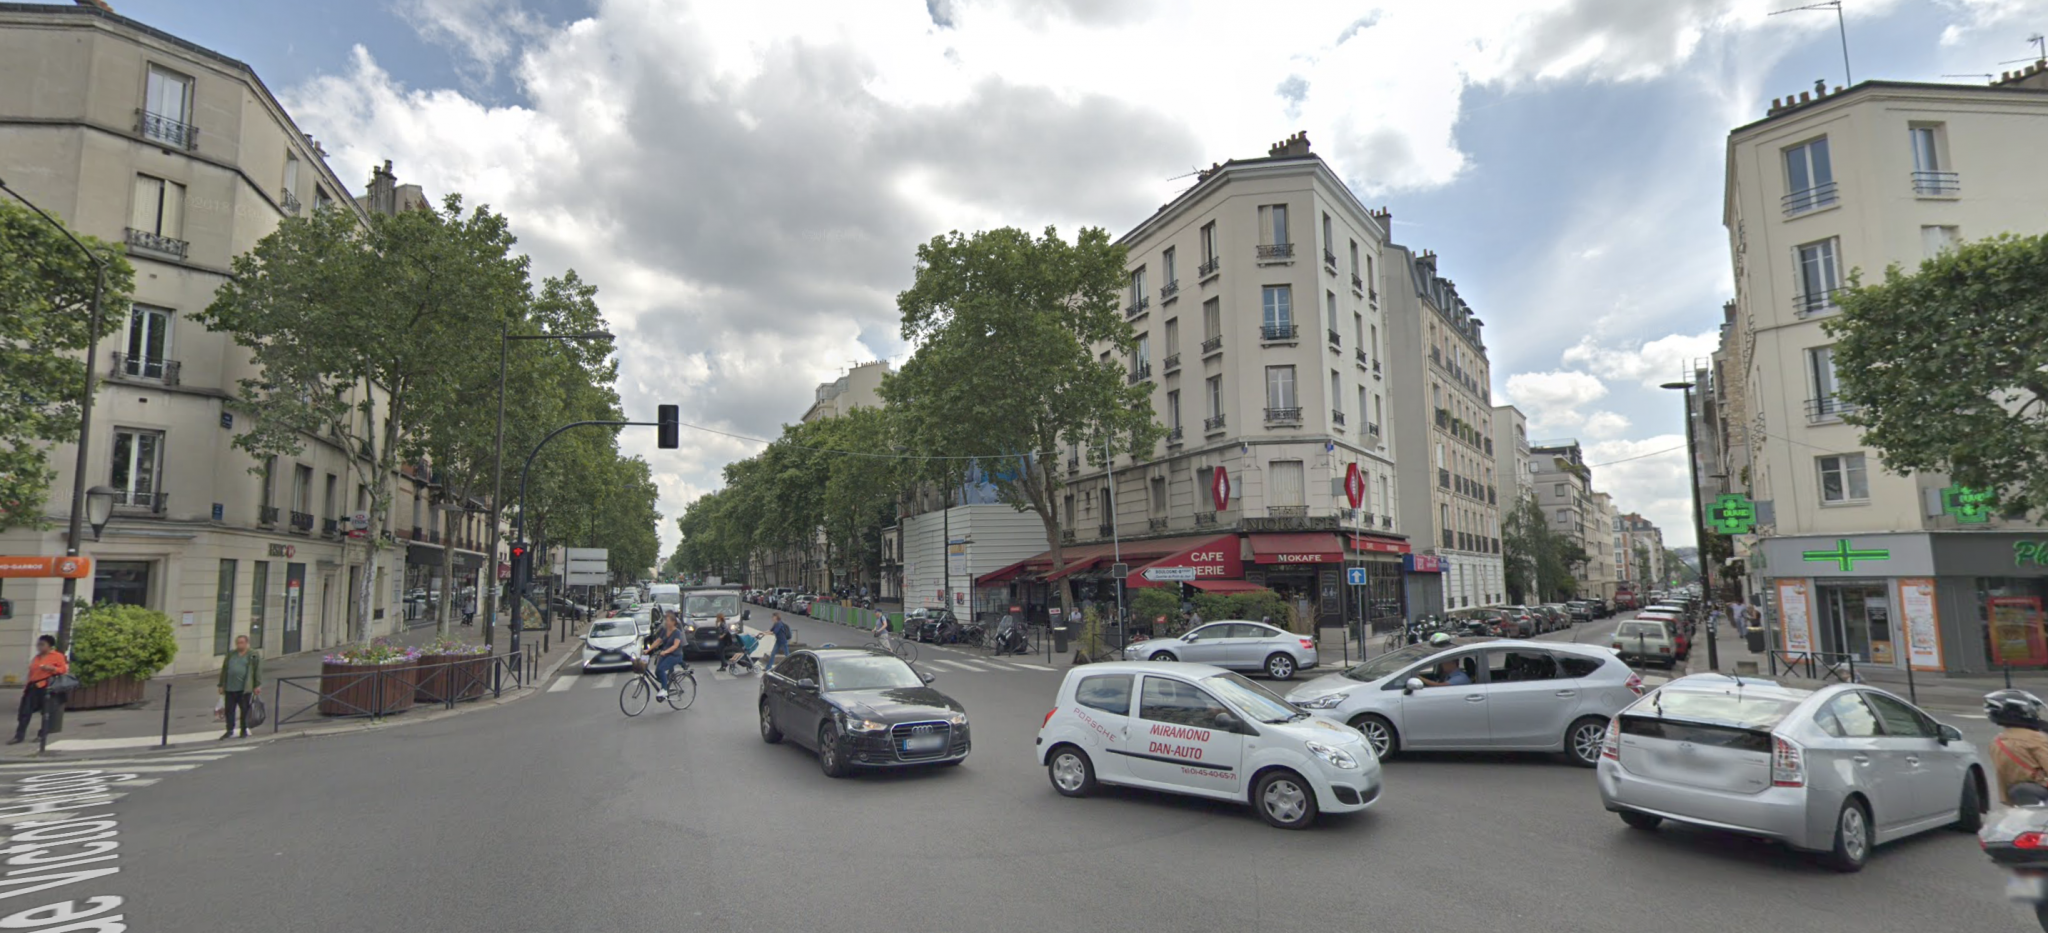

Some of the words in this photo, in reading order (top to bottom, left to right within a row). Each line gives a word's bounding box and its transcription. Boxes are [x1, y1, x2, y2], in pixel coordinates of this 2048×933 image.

[1248, 517, 1337, 529] MOKAFE
[1190, 552, 1224, 562] CAFE
[1278, 554, 1321, 562] MOKAFE
[1073, 707, 1116, 742] PORSCHE
[1150, 723, 1211, 743] MIRAMOND
[1148, 741, 1203, 759] DAN-AUTO
